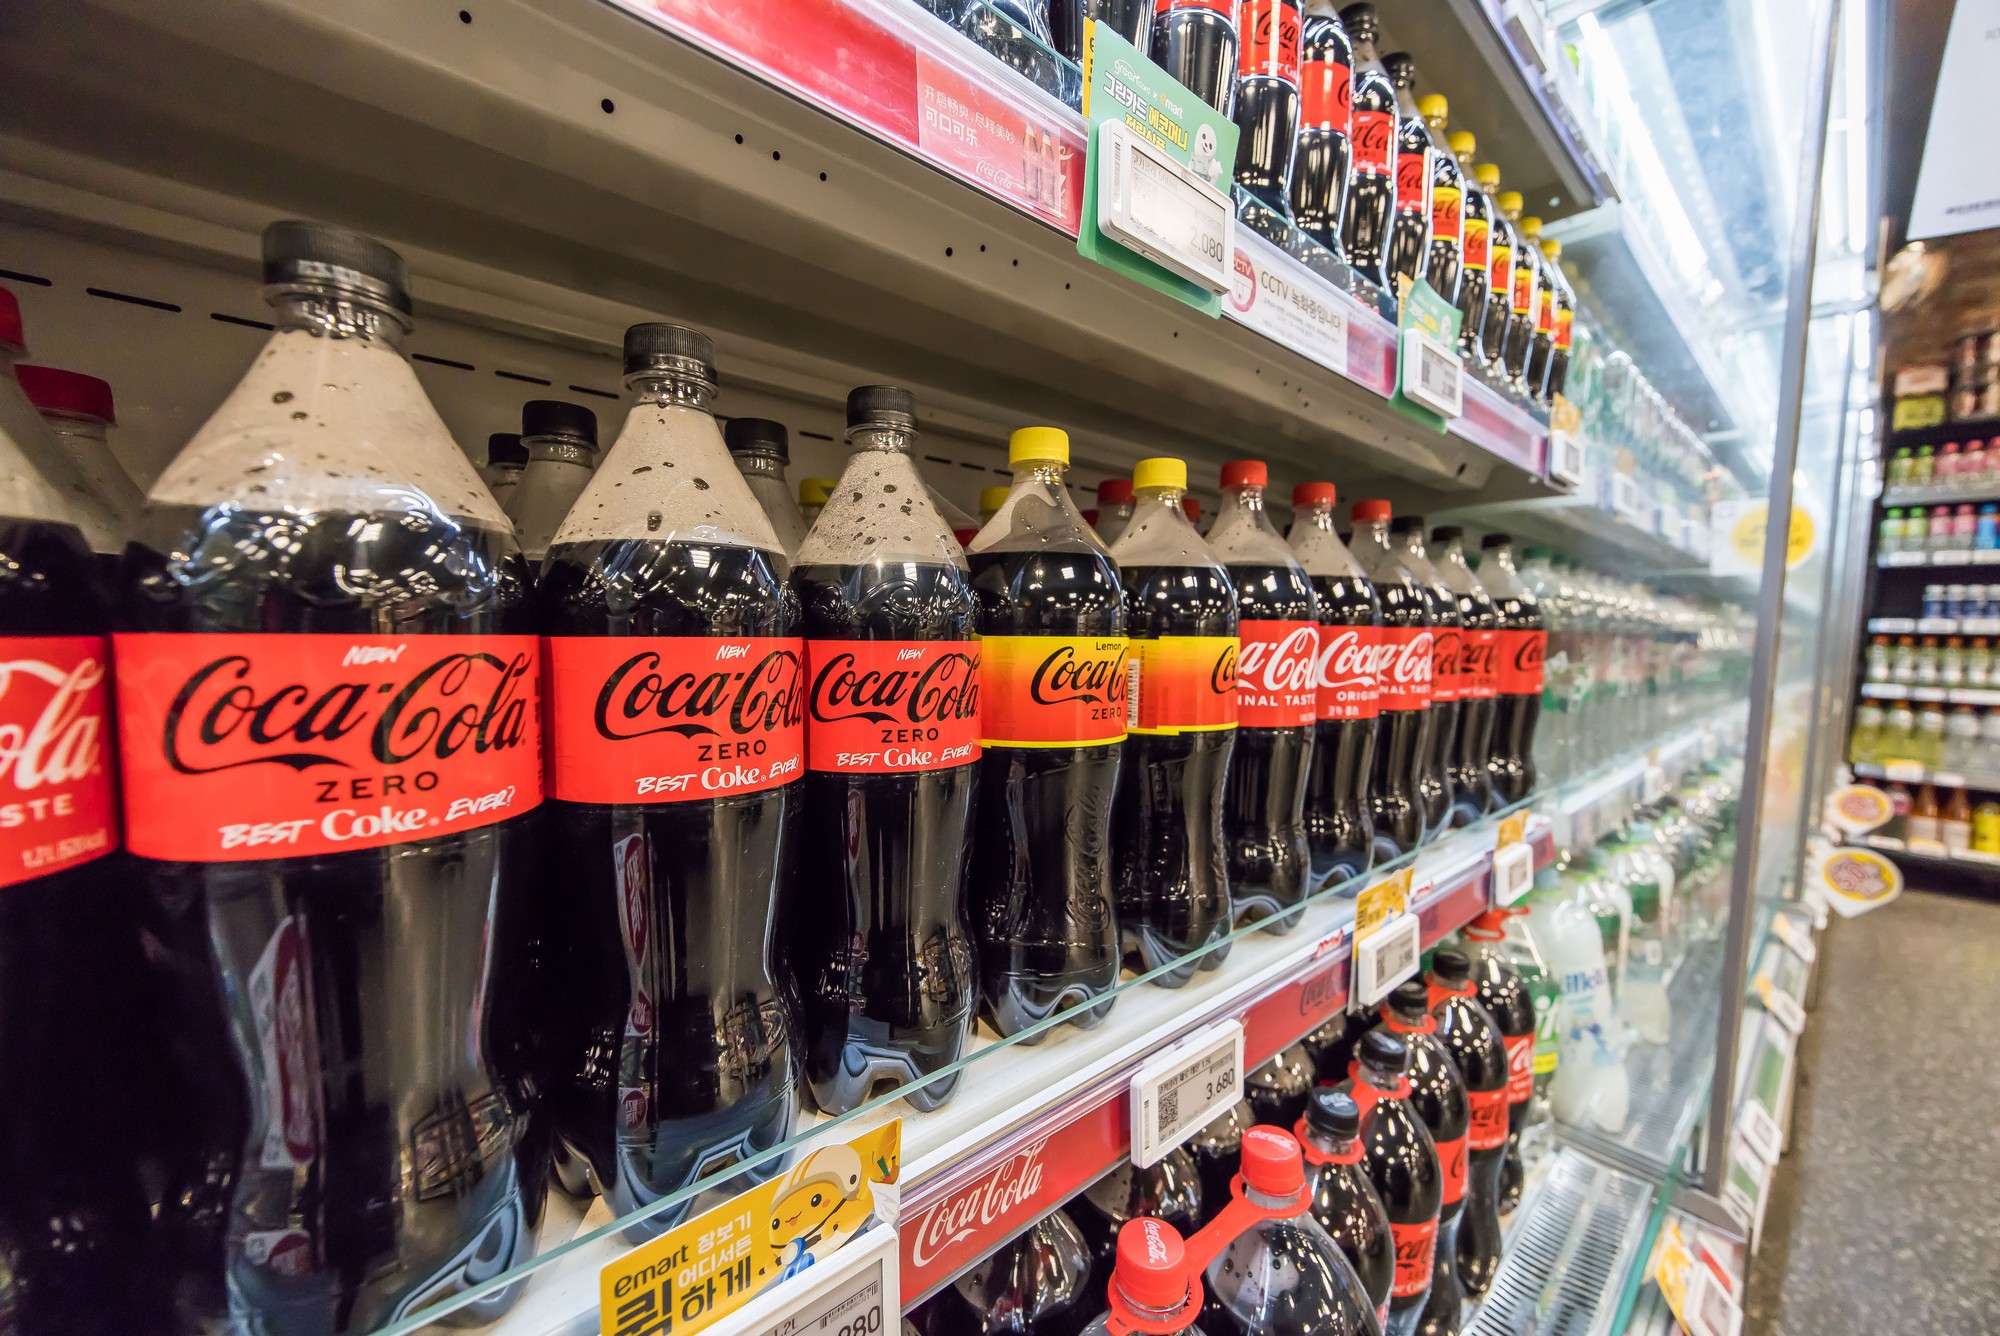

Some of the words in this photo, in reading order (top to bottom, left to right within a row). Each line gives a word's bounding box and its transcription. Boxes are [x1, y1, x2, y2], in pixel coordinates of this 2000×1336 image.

[924, 104, 979, 148] 可口可乐
[1103, 70, 1148, 121] 그린카드
[1148, 104, 1189, 151] 에코머니
[1261, 271, 1289, 300] CCTV
[1291, 288, 1341, 333] 녹화중입니다
[343, 643, 408, 667] NEW
[715, 643, 750, 661] NEW
[896, 647, 926, 661] NEW
[1095, 641, 1122, 651] Lemon
[810, 652, 980, 724] Coca-Cola
[164, 652, 533, 774] Coca-Cola
[1091, 707, 1122, 721] ZERO
[698, 740, 768, 762] ZERO
[836, 751, 880, 767] BEST
[940, 740, 973, 762] EVER?
[880, 727, 940, 744] ZERO
[315, 771, 439, 803] ZERO
[634, 773, 697, 796] BEST
[217, 819, 315, 849] BEST
[444, 785, 516, 822] EVER?
[913, 1138, 1046, 1268] Coca-Cola
[697, 1211, 751, 1255] 장보기
[1143, 1220, 1168, 1264] Coca-Cola
[614, 1245, 689, 1298] emart
[678, 1234, 752, 1287] 어디서든
